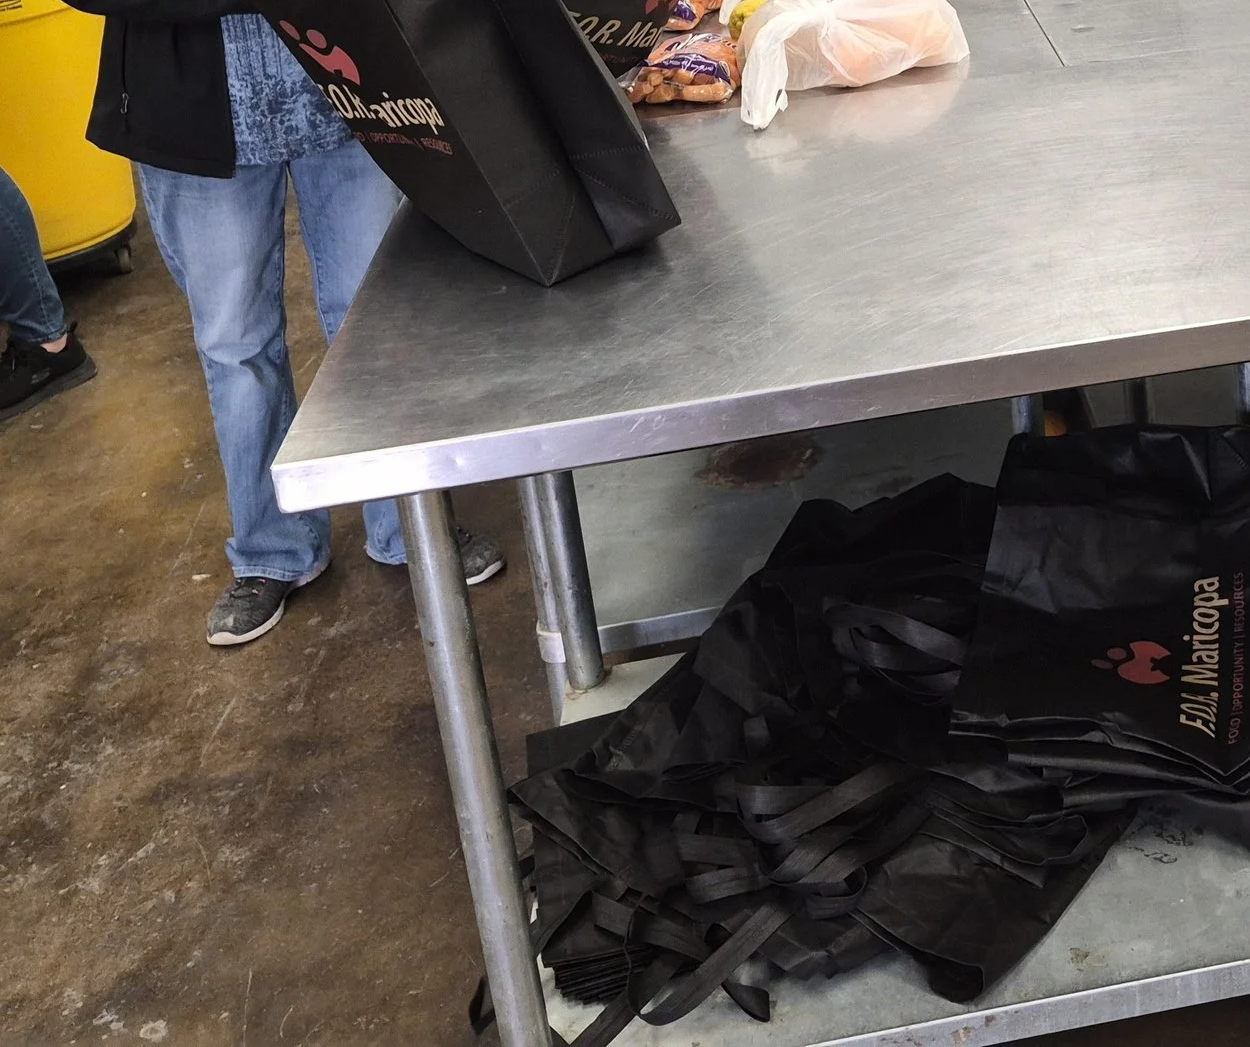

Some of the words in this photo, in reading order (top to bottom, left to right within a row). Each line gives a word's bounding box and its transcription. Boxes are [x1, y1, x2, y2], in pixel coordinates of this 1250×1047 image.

[368, 91, 445, 135] aricopa
[1180, 576, 1230, 687] Maricopa
[1233, 572, 1246, 633] RESOURCES
[1232, 642, 1245, 710] OPPORTUNITY
